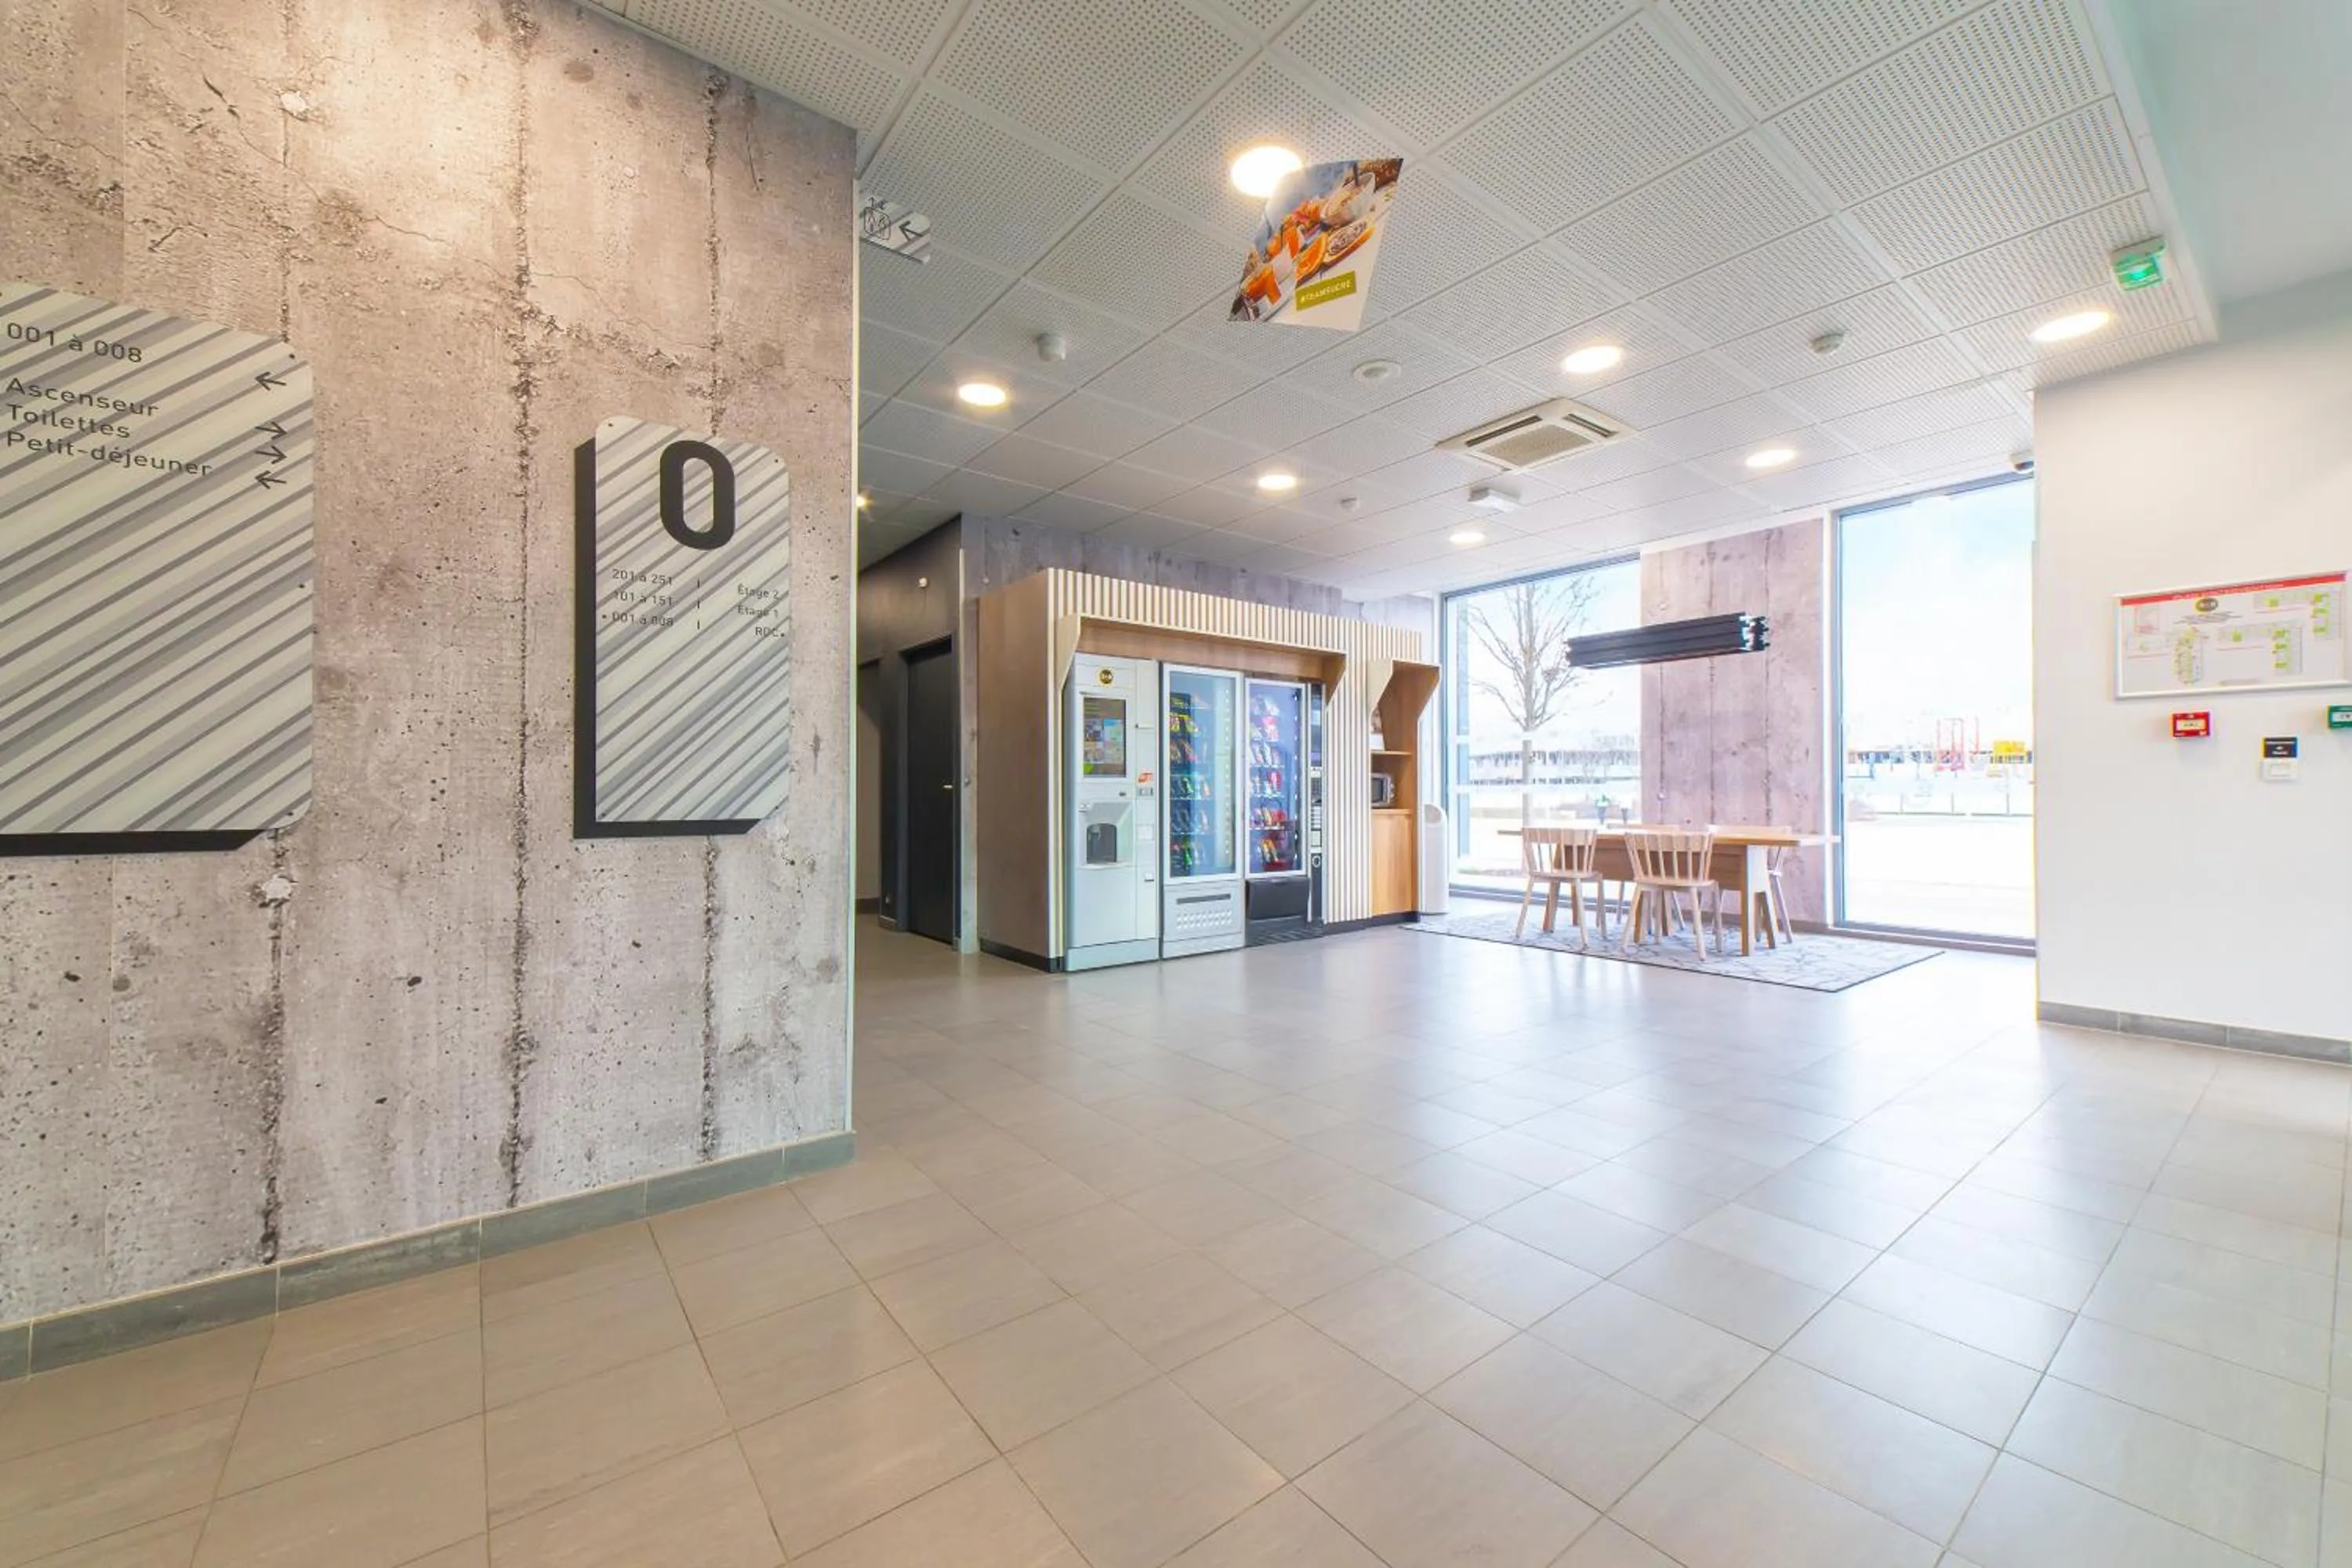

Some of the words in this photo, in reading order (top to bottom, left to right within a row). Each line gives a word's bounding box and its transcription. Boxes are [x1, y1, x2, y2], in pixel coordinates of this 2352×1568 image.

[7, 322, 56, 347] 001
[68, 334, 83, 352] à
[94, 339, 143, 363] 008
[5, 377, 160, 417] Ascenseur
[7, 404, 131, 439] Toilettes
[7, 431, 212, 476] Petit-déjeuner
[659, 440, 736, 551] 0
[612, 568, 634, 581] 201
[652, 573, 672, 585] 251
[615, 590, 634, 602] 101
[652, 595, 672, 606] 151
[773, 590, 779, 600] 2
[612, 612, 634, 623] 001
[773, 609, 779, 619] 1
[755, 626, 779, 637] RDC
